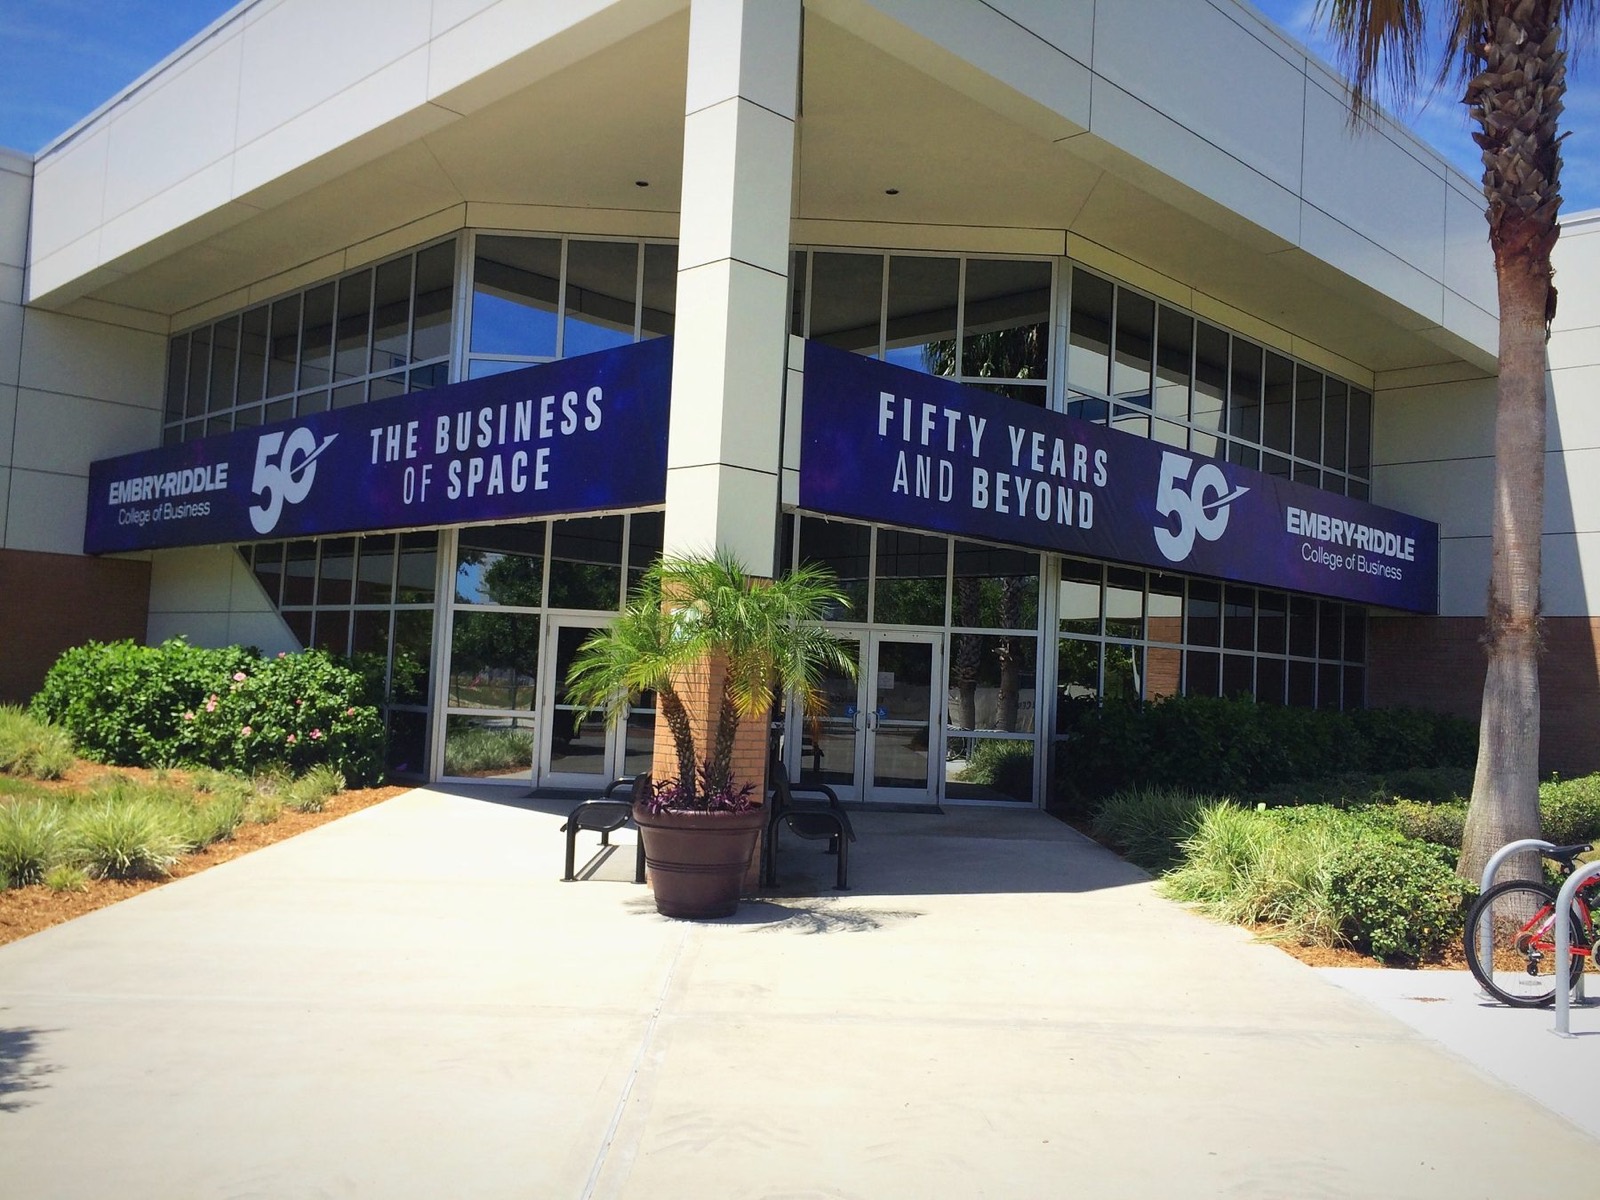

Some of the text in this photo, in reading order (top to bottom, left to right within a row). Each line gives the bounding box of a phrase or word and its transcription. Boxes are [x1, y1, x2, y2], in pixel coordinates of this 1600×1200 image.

[371, 386, 602, 464] THE BUSINESS
[878, 391, 1108, 488] FIFTY YEARS
[109, 463, 229, 505] EMBRY-RIDDLE
[249, 427, 317, 534] 50
[403, 448, 550, 505] OF SPACE
[892, 450, 1093, 530] AND BEYOND
[1153, 450, 1230, 562] 50
[118, 502, 211, 526] College of Business
[1287, 507, 1415, 562] EMBRY-RIDDLE
[1302, 543, 1402, 580] College of Business
